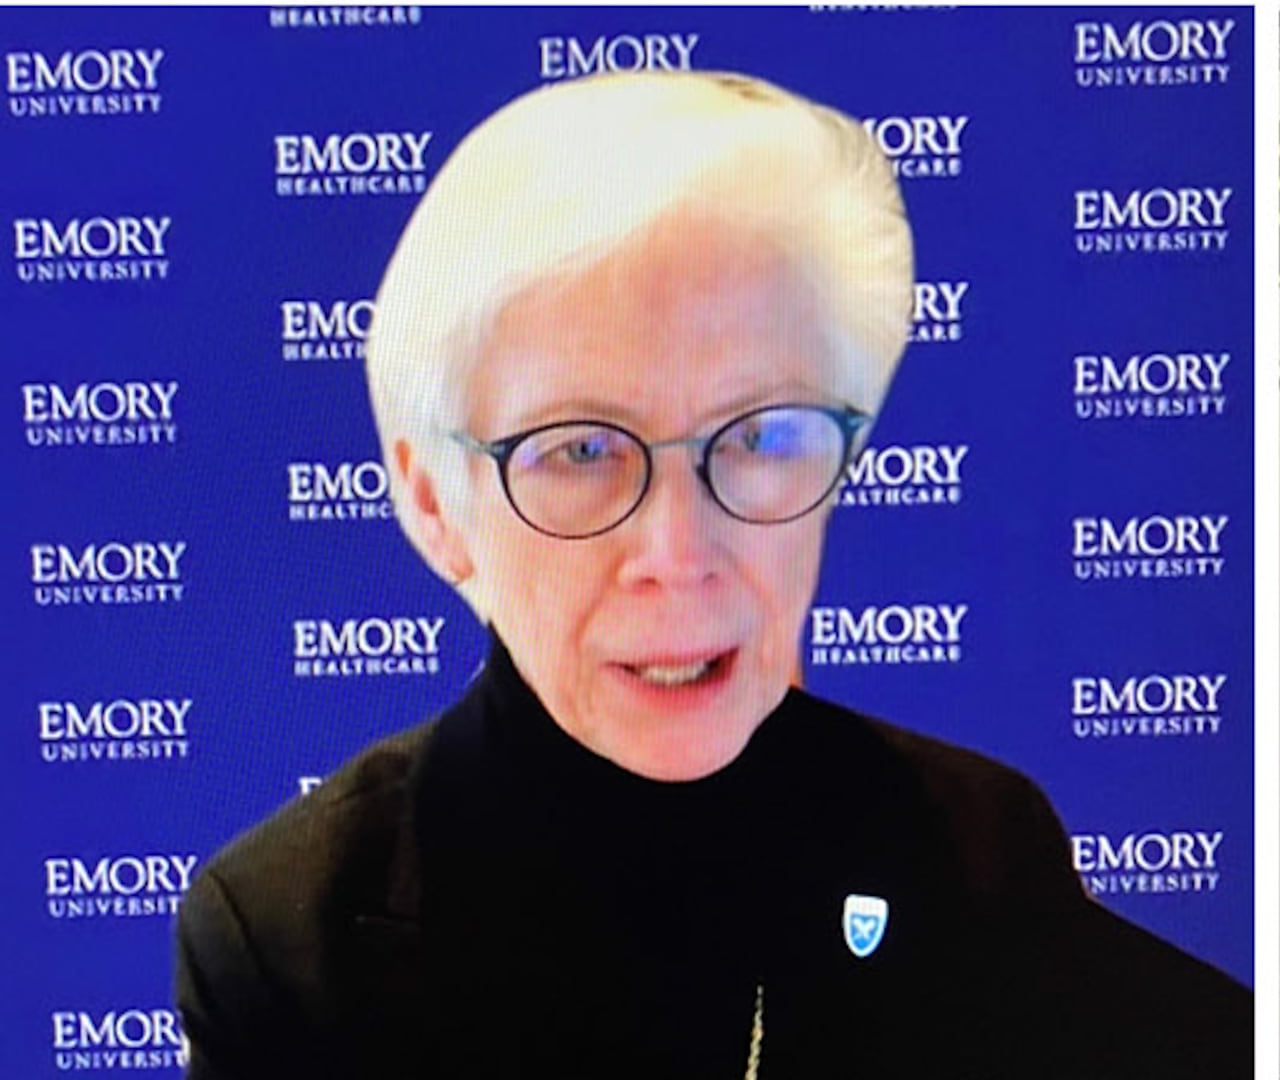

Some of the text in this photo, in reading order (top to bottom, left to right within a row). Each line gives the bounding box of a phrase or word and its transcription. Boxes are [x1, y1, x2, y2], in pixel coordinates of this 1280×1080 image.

[538, 34, 698, 78] EMORY
[1075, 19, 1234, 62] EMORY
[6, 49, 163, 93] EMORY
[1077, 64, 1228, 86] UNIVERSITY
[10, 93, 160, 115] UNIVERSITY
[274, 132, 433, 176] EMORY
[862, 116, 968, 156] ORY
[276, 176, 426, 196] HEALTHCARE
[1074, 188, 1232, 229] EMORY
[14, 217, 171, 259] EMORY
[1077, 231, 1227, 251] UNIVERSITY
[18, 260, 167, 280] UNIVERSITY
[281, 299, 376, 341] EMO
[282, 342, 366, 361] HEALT
[1074, 353, 1230, 395] EMORY
[22, 382, 178, 423] EMORY
[1076, 396, 1225, 417] UNIVERSITY
[26, 424, 175, 445] UNIVERSITY
[287, 461, 388, 502] EMO
[841, 445, 968, 486] MORY
[289, 502, 394, 521] HEALTHC
[836, 486, 962, 505] ALTHCARE
[1073, 515, 1228, 557] EMORY
[31, 542, 186, 583] EMORY
[1075, 557, 1223, 578] UNIVERSITY
[35, 584, 183, 604] UNIVERSITY
[293, 617, 445, 658] EMORY
[811, 605, 968, 646] EMORY
[294, 657, 440, 677] HEALTHCARE
[811, 645, 960, 665] HEALTHCARE
[1072, 675, 1226, 715] EMORY
[39, 699, 192, 741] EMORY
[1074, 716, 1220, 737] UNIVERSITY
[42, 740, 188, 761] UNIVERSITY
[1070, 831, 1224, 872] EMORY
[45, 855, 198, 896] EMORY
[1082, 871, 1220, 894] NIVERSITY
[49, 896, 180, 918] UNIVERSIT
[52, 1009, 182, 1048] EMOR
[56, 1048, 184, 1070] UNIVERSIT
